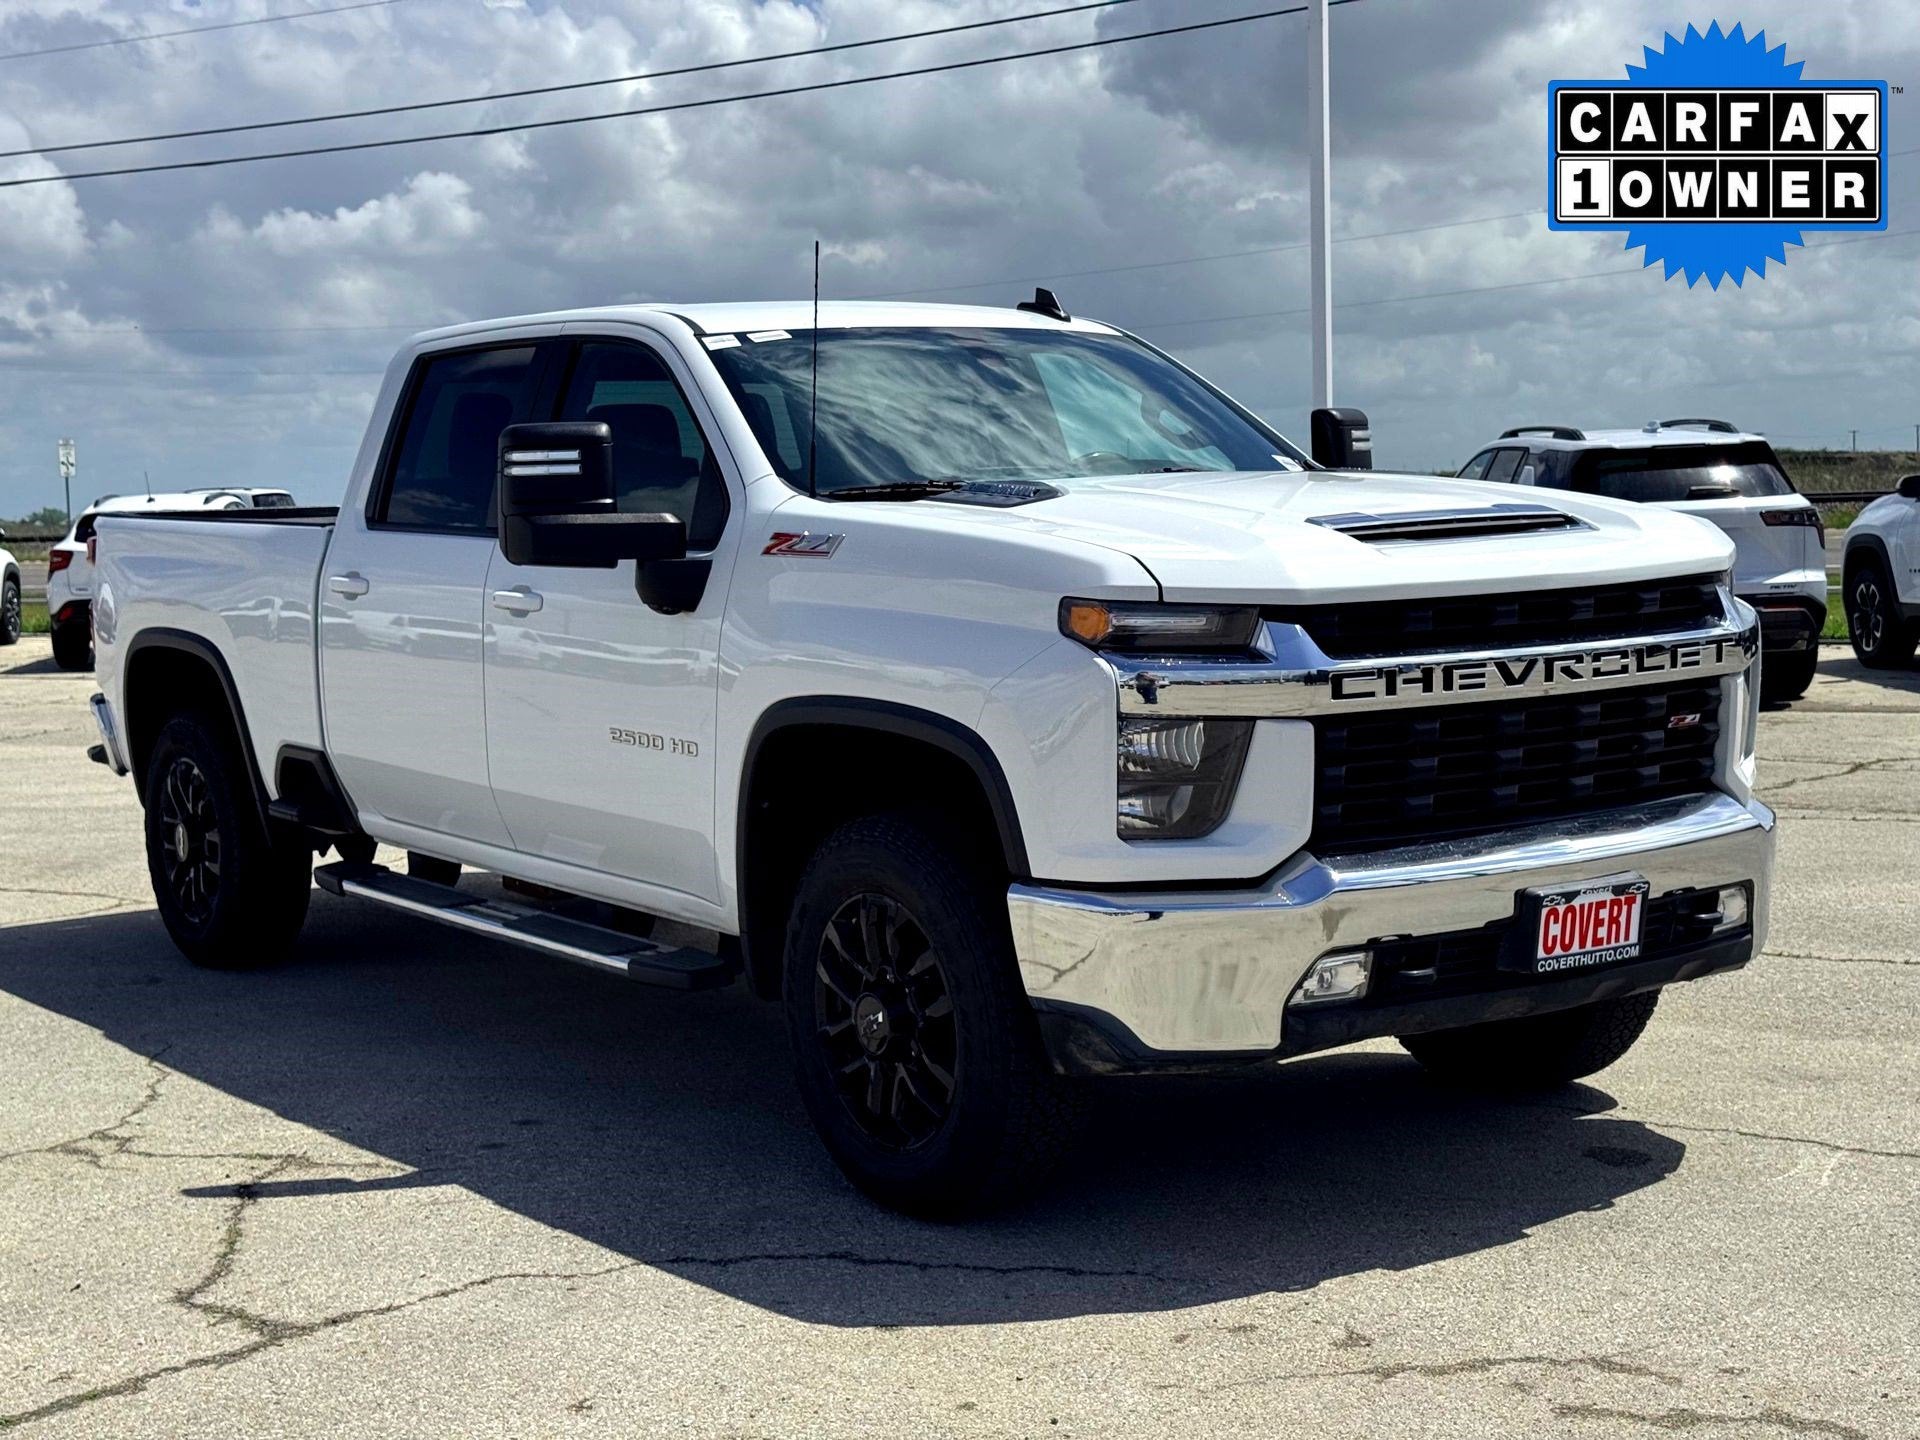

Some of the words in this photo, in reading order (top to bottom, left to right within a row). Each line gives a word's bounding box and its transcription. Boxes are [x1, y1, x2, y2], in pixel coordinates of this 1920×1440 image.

[761, 531, 846, 560] Z71
[1329, 637, 1735, 702] CHEVROLET
[609, 727, 664, 751] 2500
[670, 737, 699, 758] HD
[1542, 894, 1637, 956] COVERT
[1537, 945, 1640, 973] COVERTHUTTO.COM
